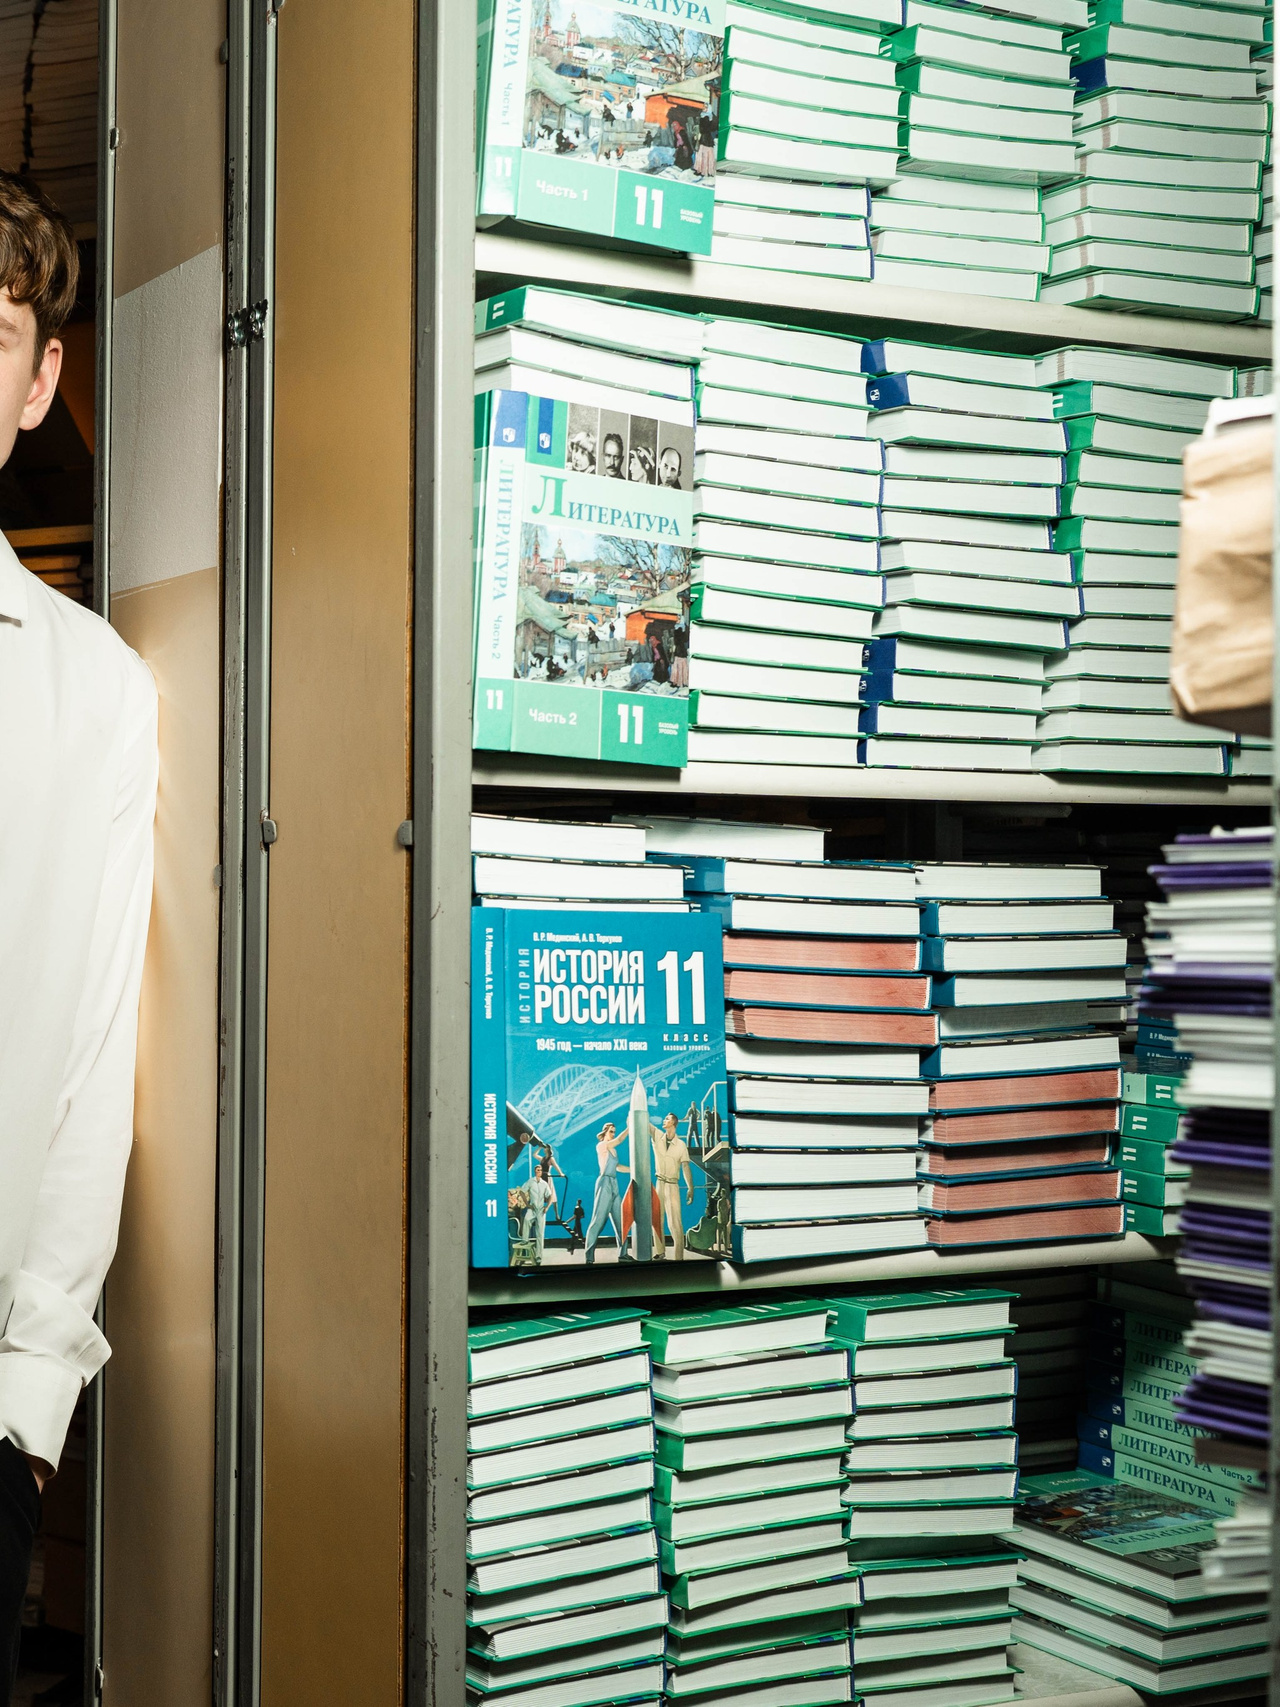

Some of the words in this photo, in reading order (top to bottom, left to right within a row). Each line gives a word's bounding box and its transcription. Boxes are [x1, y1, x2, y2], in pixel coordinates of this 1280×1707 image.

[494, 156, 513, 177] 11
[536, 179, 578, 199] Часть
[582, 188, 589, 201] 1
[634, 185, 664, 229] 11
[531, 475, 681, 536] ЛИТЕРАТУРА
[492, 459, 515, 602] ЛИТЕРАТУРА
[492, 615, 503, 649] Часть
[486, 690, 504, 710] 11
[529, 708, 566, 724] Часть
[569, 712, 578, 725] 2
[617, 703, 644, 745] 11
[533, 932, 540, 942] В.
[540, 932, 546, 942] Р.
[581, 934, 588, 942] А.
[589, 934, 595, 942] В.
[533, 949, 645, 984] ИСТОРИЯ
[518, 948, 531, 1024] ИСТОРИЯ
[656, 950, 706, 1025] 11
[534, 984, 646, 1025] РОССИИ
[536, 1038, 556, 1051] 1945
[557, 1041, 572, 1052] год
[584, 1040, 612, 1051] начало
[613, 1038, 627, 1050] XXI
[629, 1041, 648, 1051] века
[1155, 1085, 1171, 1099] 11
[484, 1093, 497, 1140] ИСТОРИЯ
[1132, 1116, 1148, 1130] 11
[484, 1143, 497, 1184] РОССИИ
[1122, 1147, 1137, 1161] 11
[1124, 1179, 1138, 1194] 11
[485, 1199, 497, 1217] 11
[1122, 1462, 1217, 1503] ЛИТЕРАТУРА
[1221, 1467, 1246, 1481] Часть
[1246, 1474, 1253, 1483] 2
